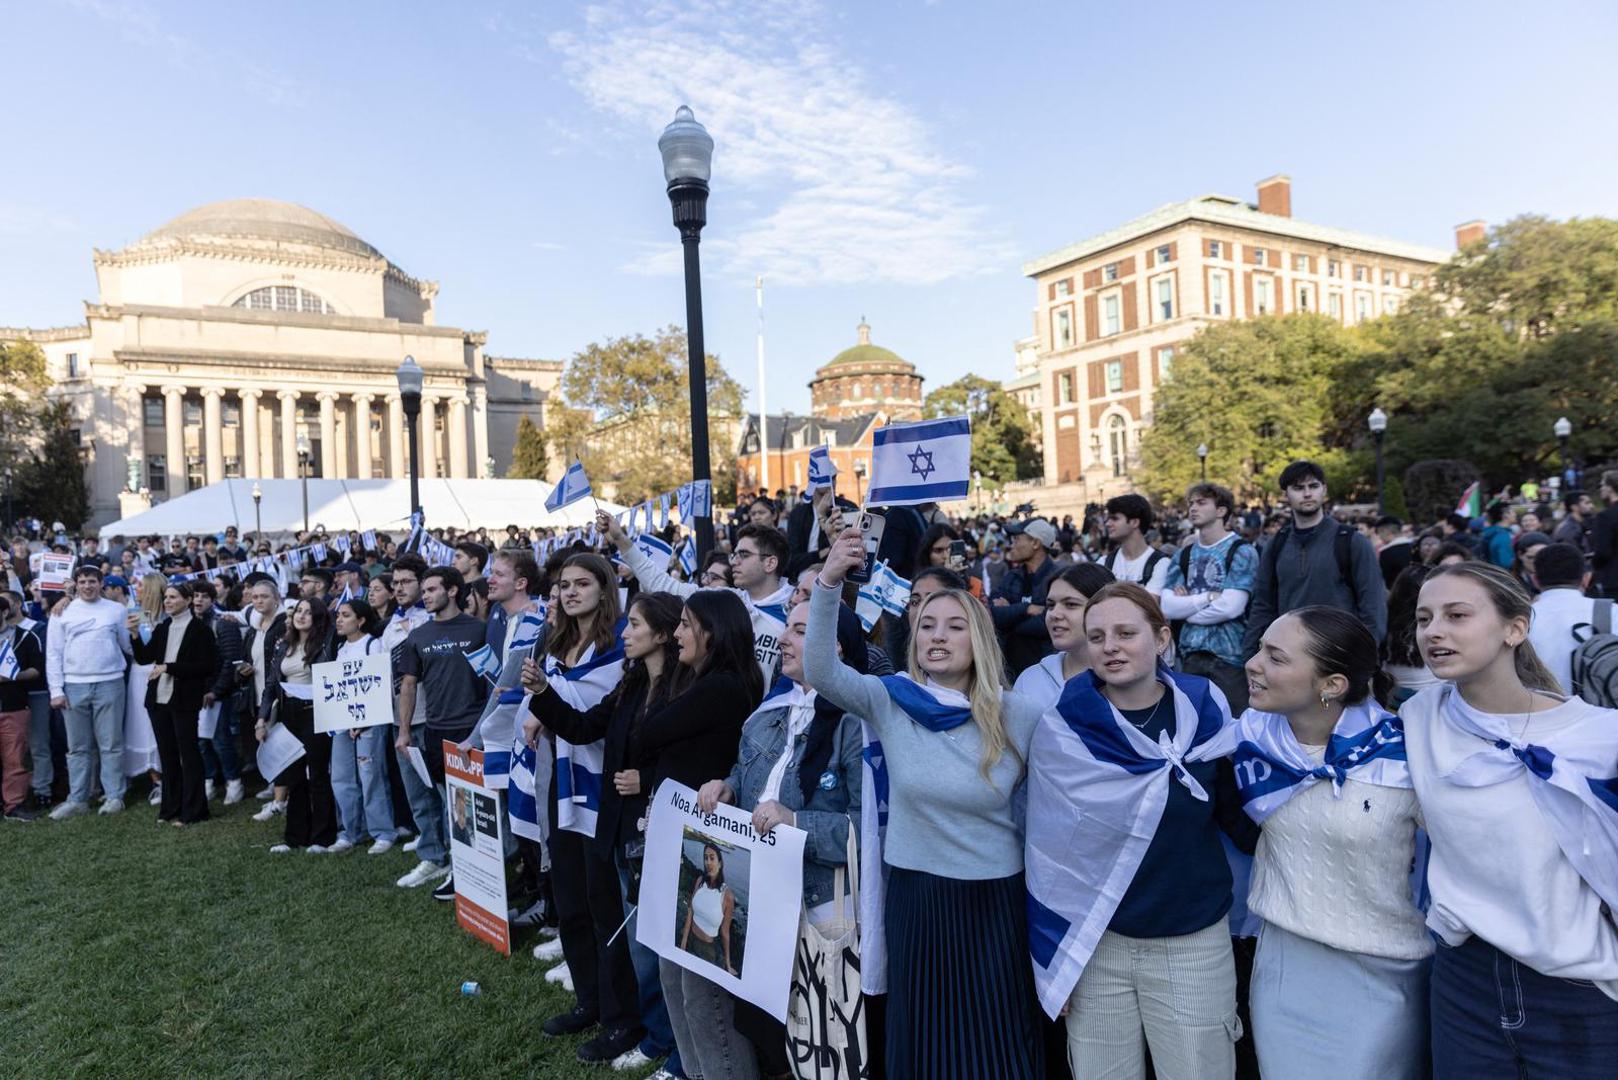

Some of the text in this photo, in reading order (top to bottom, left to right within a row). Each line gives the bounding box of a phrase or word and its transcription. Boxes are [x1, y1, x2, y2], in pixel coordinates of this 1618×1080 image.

[343, 660, 363, 677] עם
[322, 675, 382, 703] ישראל
[348, 702, 366, 721] חי
[671, 791, 690, 814] Noa
[760, 830, 777, 846] 25
